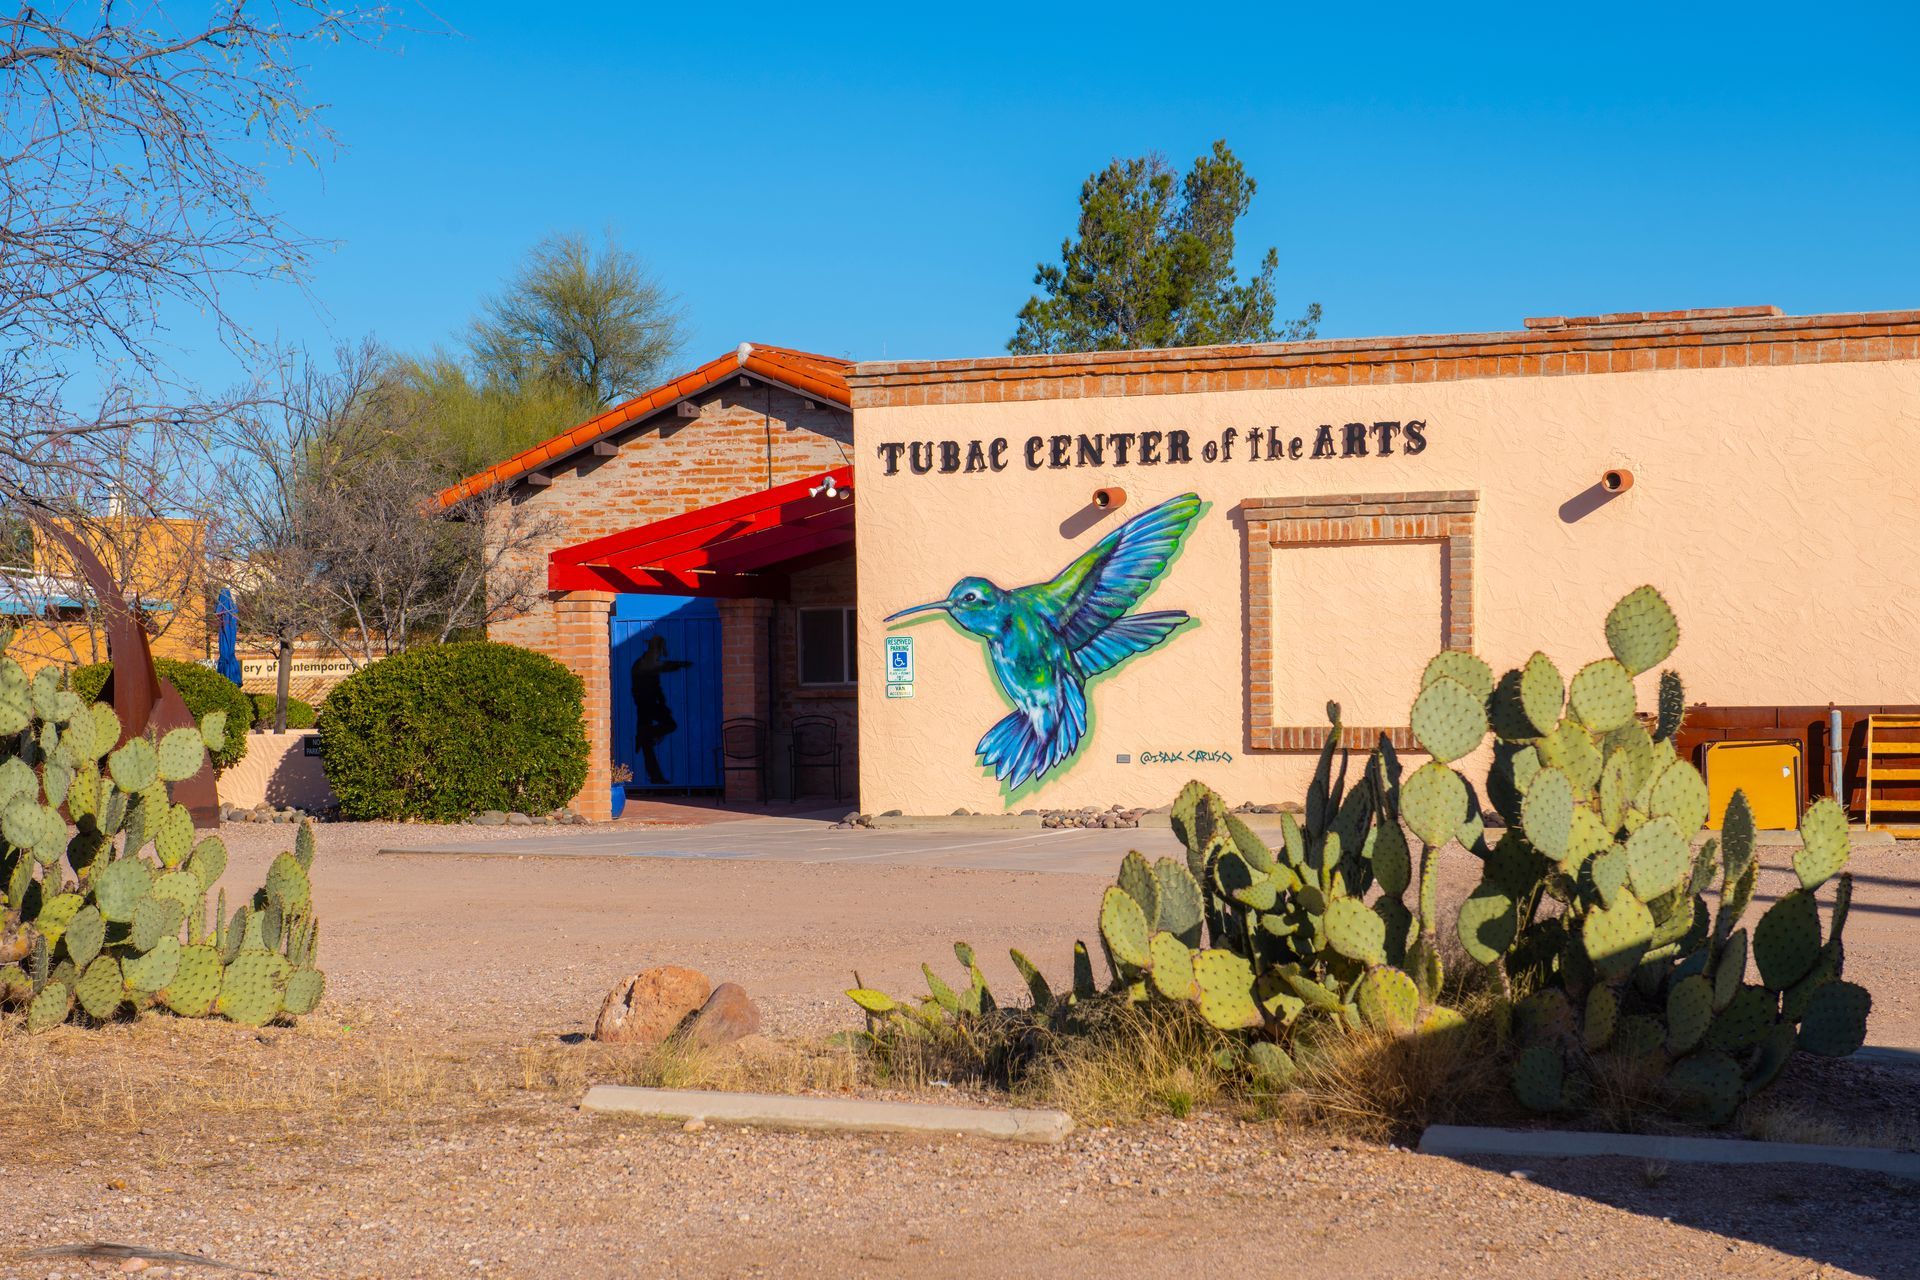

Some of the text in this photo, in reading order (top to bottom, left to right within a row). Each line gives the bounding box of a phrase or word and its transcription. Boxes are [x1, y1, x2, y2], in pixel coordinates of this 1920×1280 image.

[880, 419, 1427, 475] TUBAC CENTER of the ARTS
[243, 665, 261, 674] ery
[266, 663, 277, 672] of
